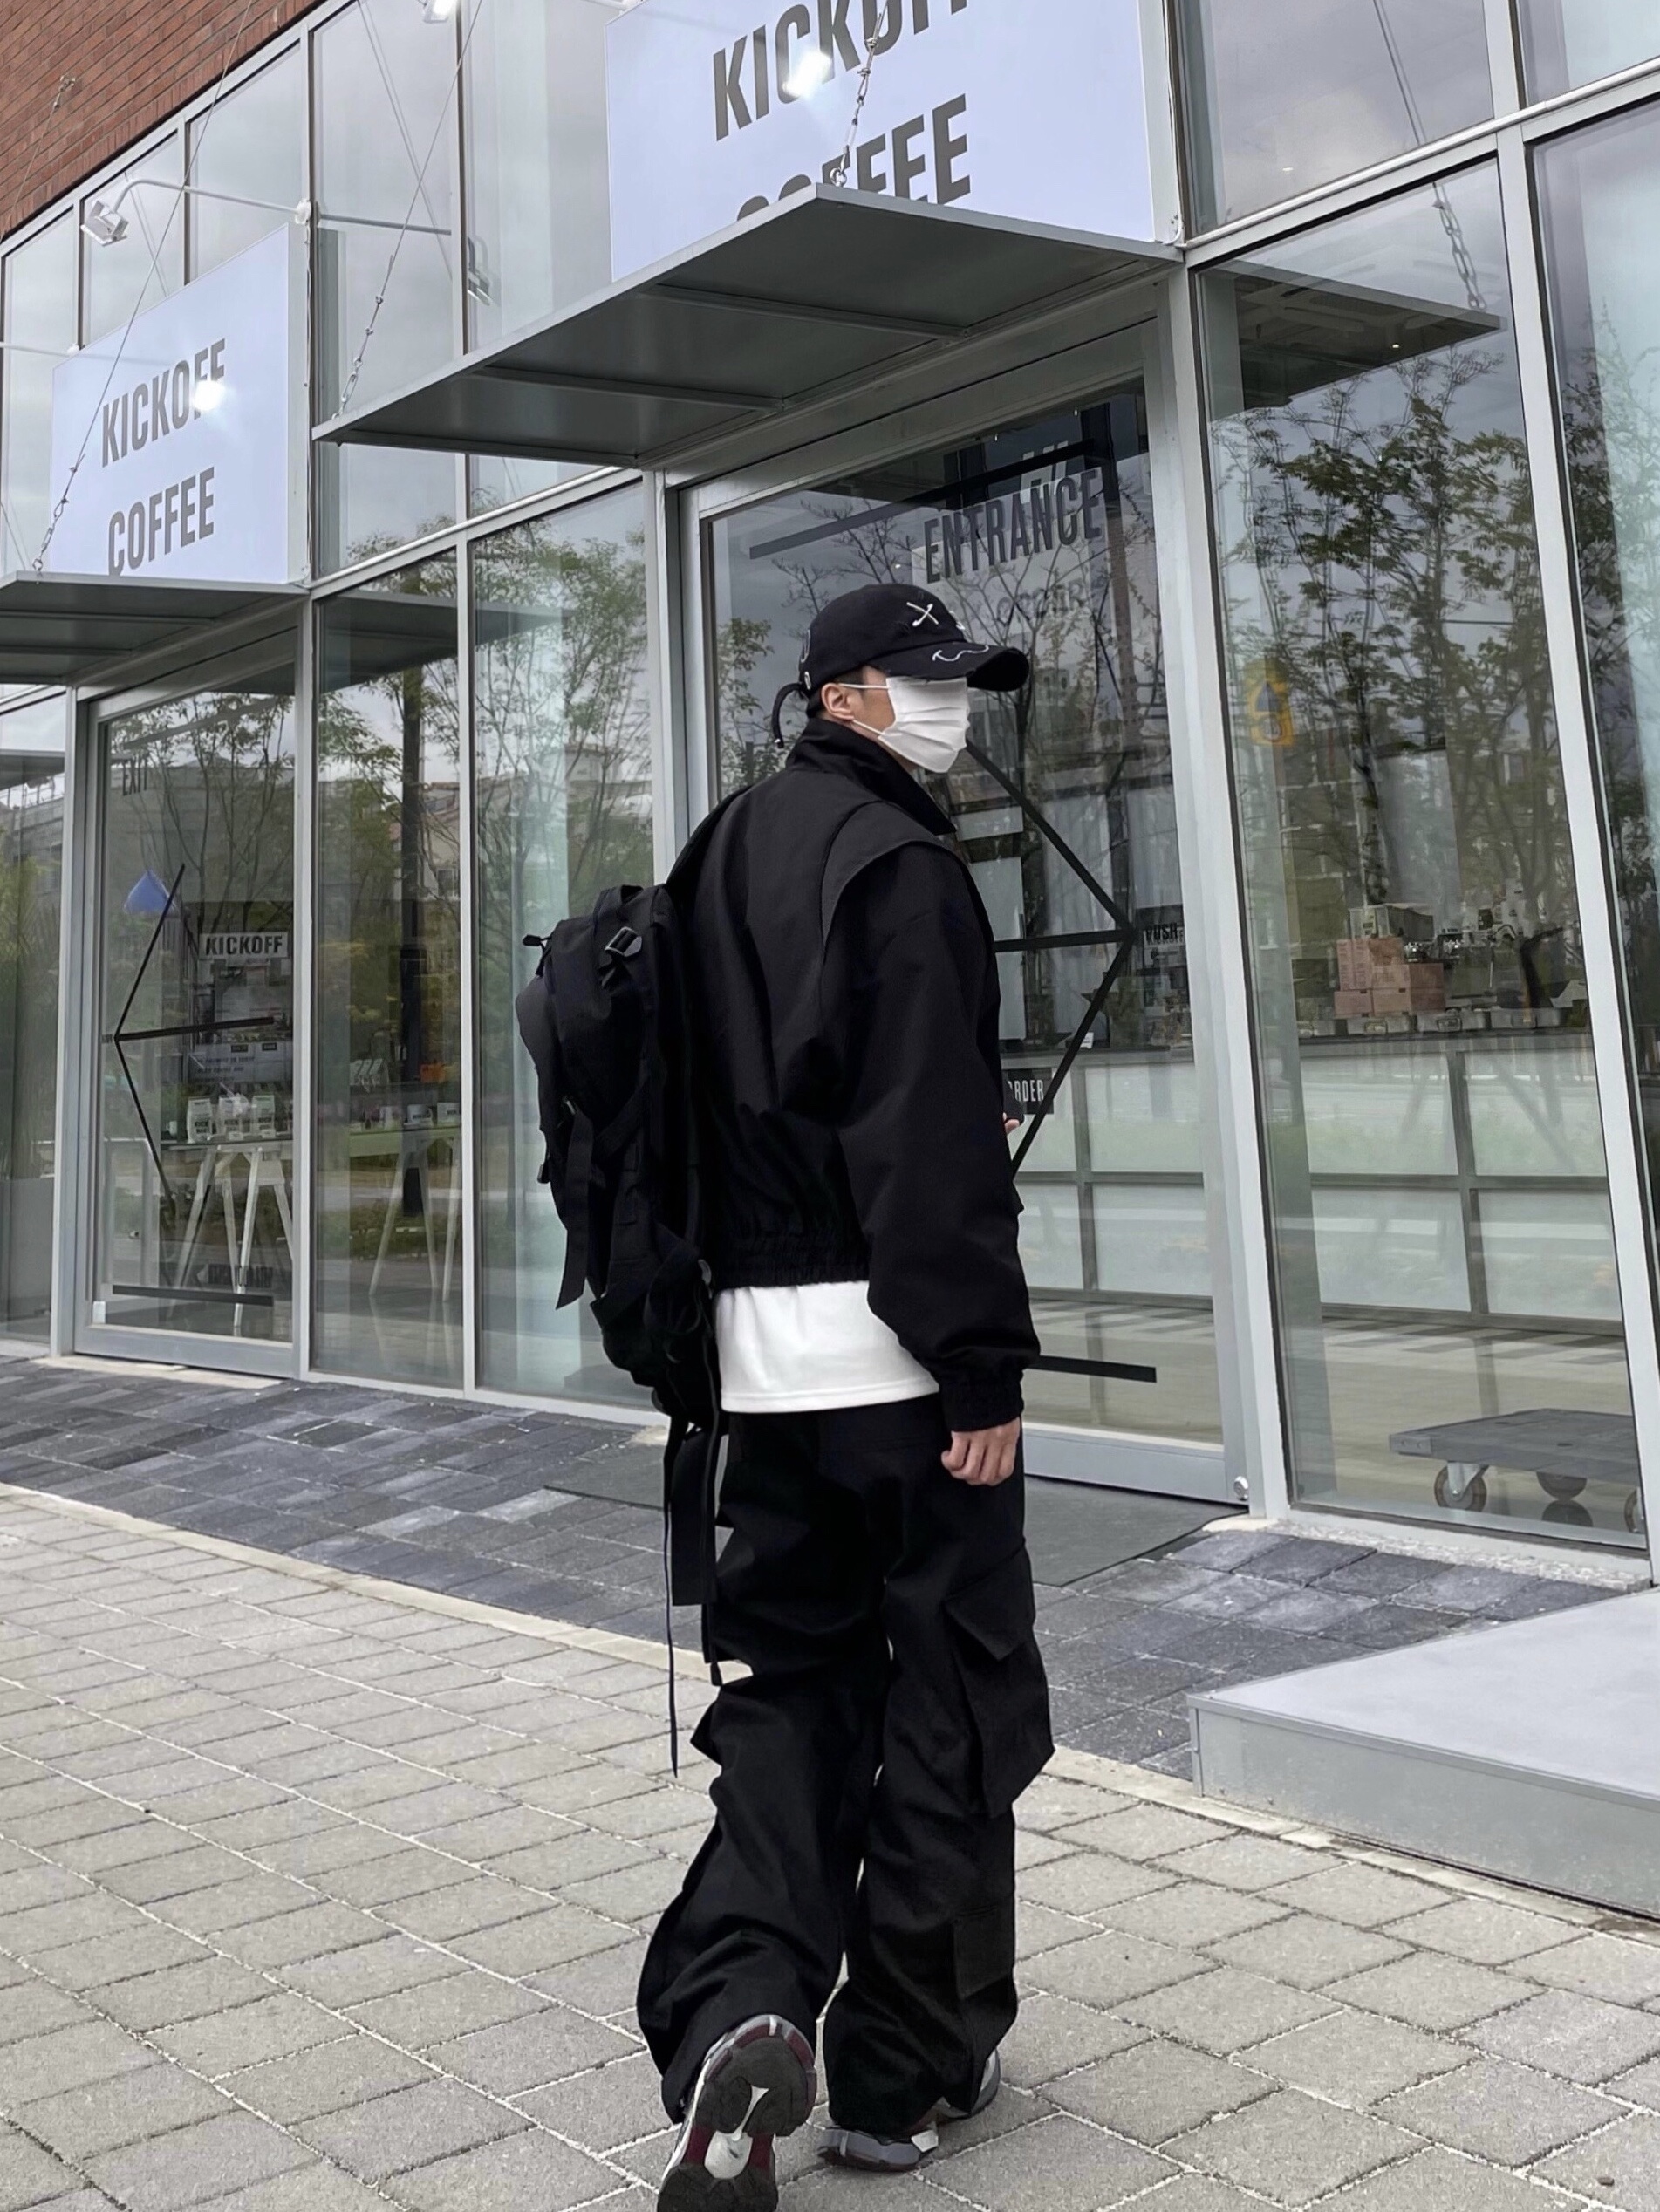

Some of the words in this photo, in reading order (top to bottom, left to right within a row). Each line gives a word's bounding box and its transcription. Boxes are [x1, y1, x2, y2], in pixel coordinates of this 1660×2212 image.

[713, 0, 967, 141] KICKO
[102, 338, 226, 468] KICKOFF
[108, 466, 215, 577] COFFEE
[924, 469, 1102, 584] ENTRANCE
[122, 755, 149, 796] EXIT
[206, 935, 283, 956] KICKOFF
